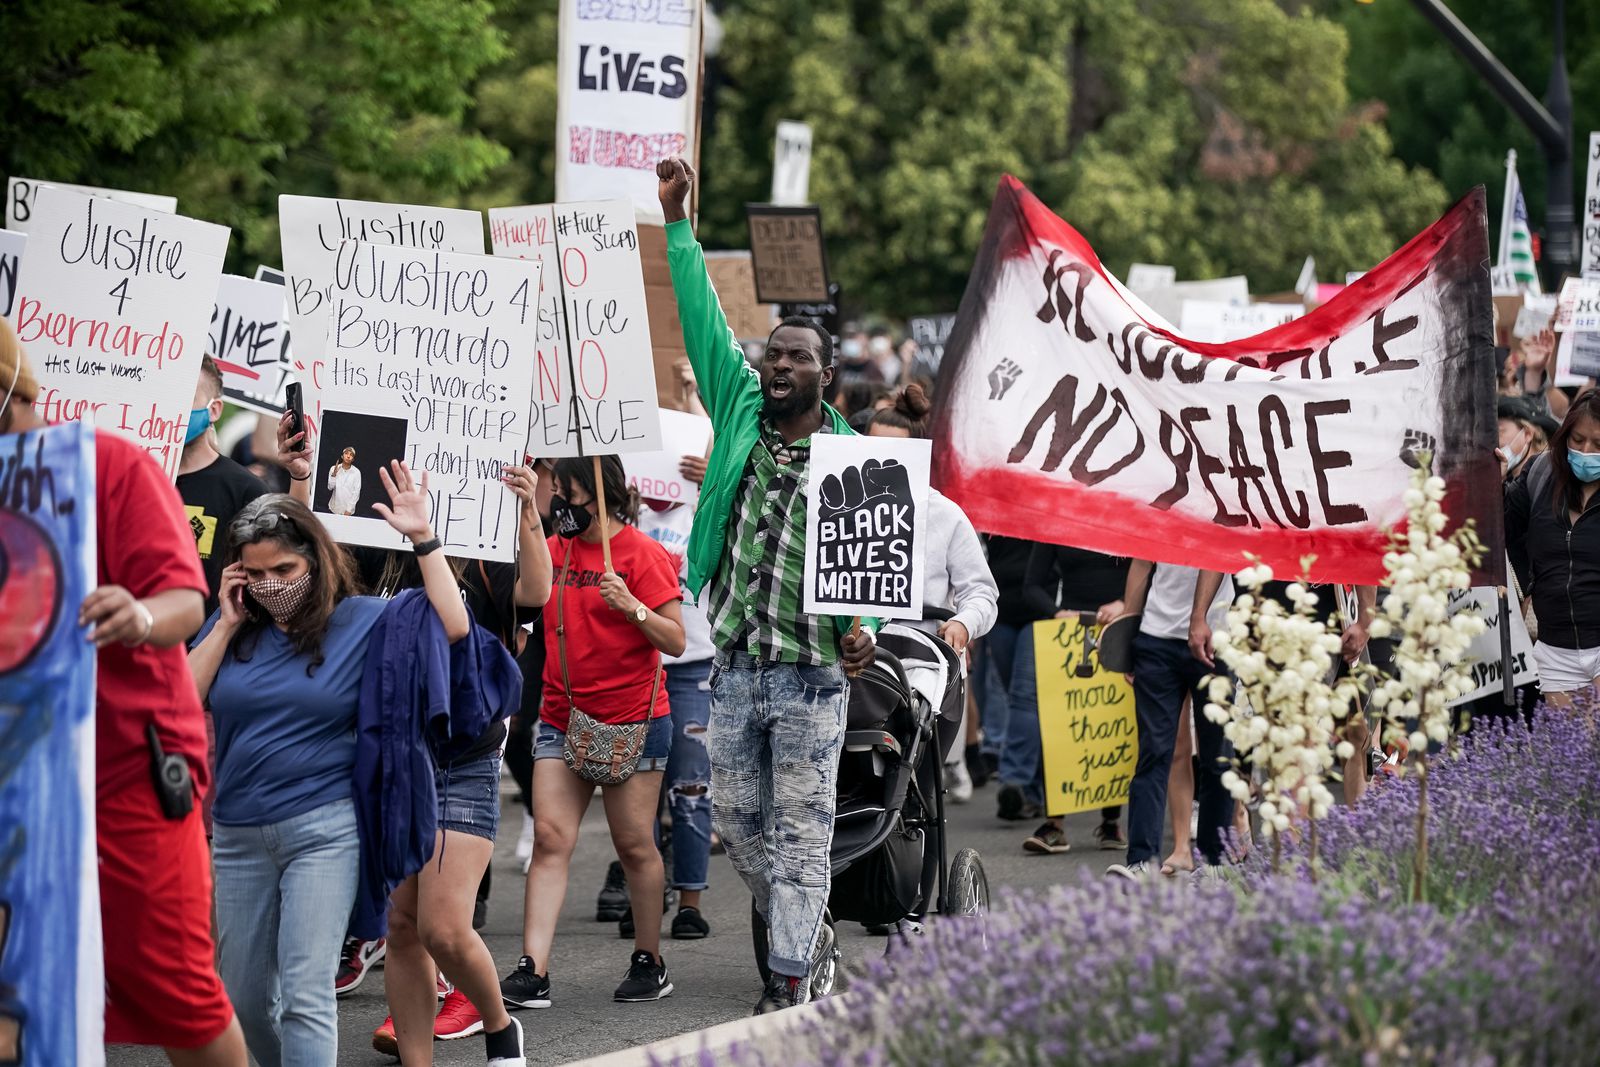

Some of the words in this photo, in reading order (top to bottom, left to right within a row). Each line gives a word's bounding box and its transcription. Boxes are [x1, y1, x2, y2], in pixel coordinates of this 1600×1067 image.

[60, 199, 187, 280] Justice
[318, 201, 445, 251] Justice
[557, 211, 610, 237] #Fuck
[109, 278, 132, 315] 4
[336, 238, 494, 317] Justice
[509, 278, 530, 324] 4
[17, 297, 184, 369] Bernardo
[336, 299, 510, 378] Bernardo
[45, 354, 70, 374] His
[332, 357, 368, 386] His
[377, 362, 424, 392] Last
[430, 372, 507, 402] words:
[537, 340, 608, 404] NO
[117, 404, 134, 430] I
[139, 403, 188, 444] dont
[408, 443, 421, 470] I
[424, 442, 475, 478] dont
[1007, 373, 1146, 487] NO
[1149, 394, 1368, 531] PEACE
[456, 478, 470, 495] 2
[820, 502, 912, 543] BLACK
[819, 538, 909, 572] LIVES
[818, 570, 909, 603] MATTER
[1065, 683, 1126, 711] more
[1069, 715, 1135, 743] than
[1078, 742, 1133, 782] just
